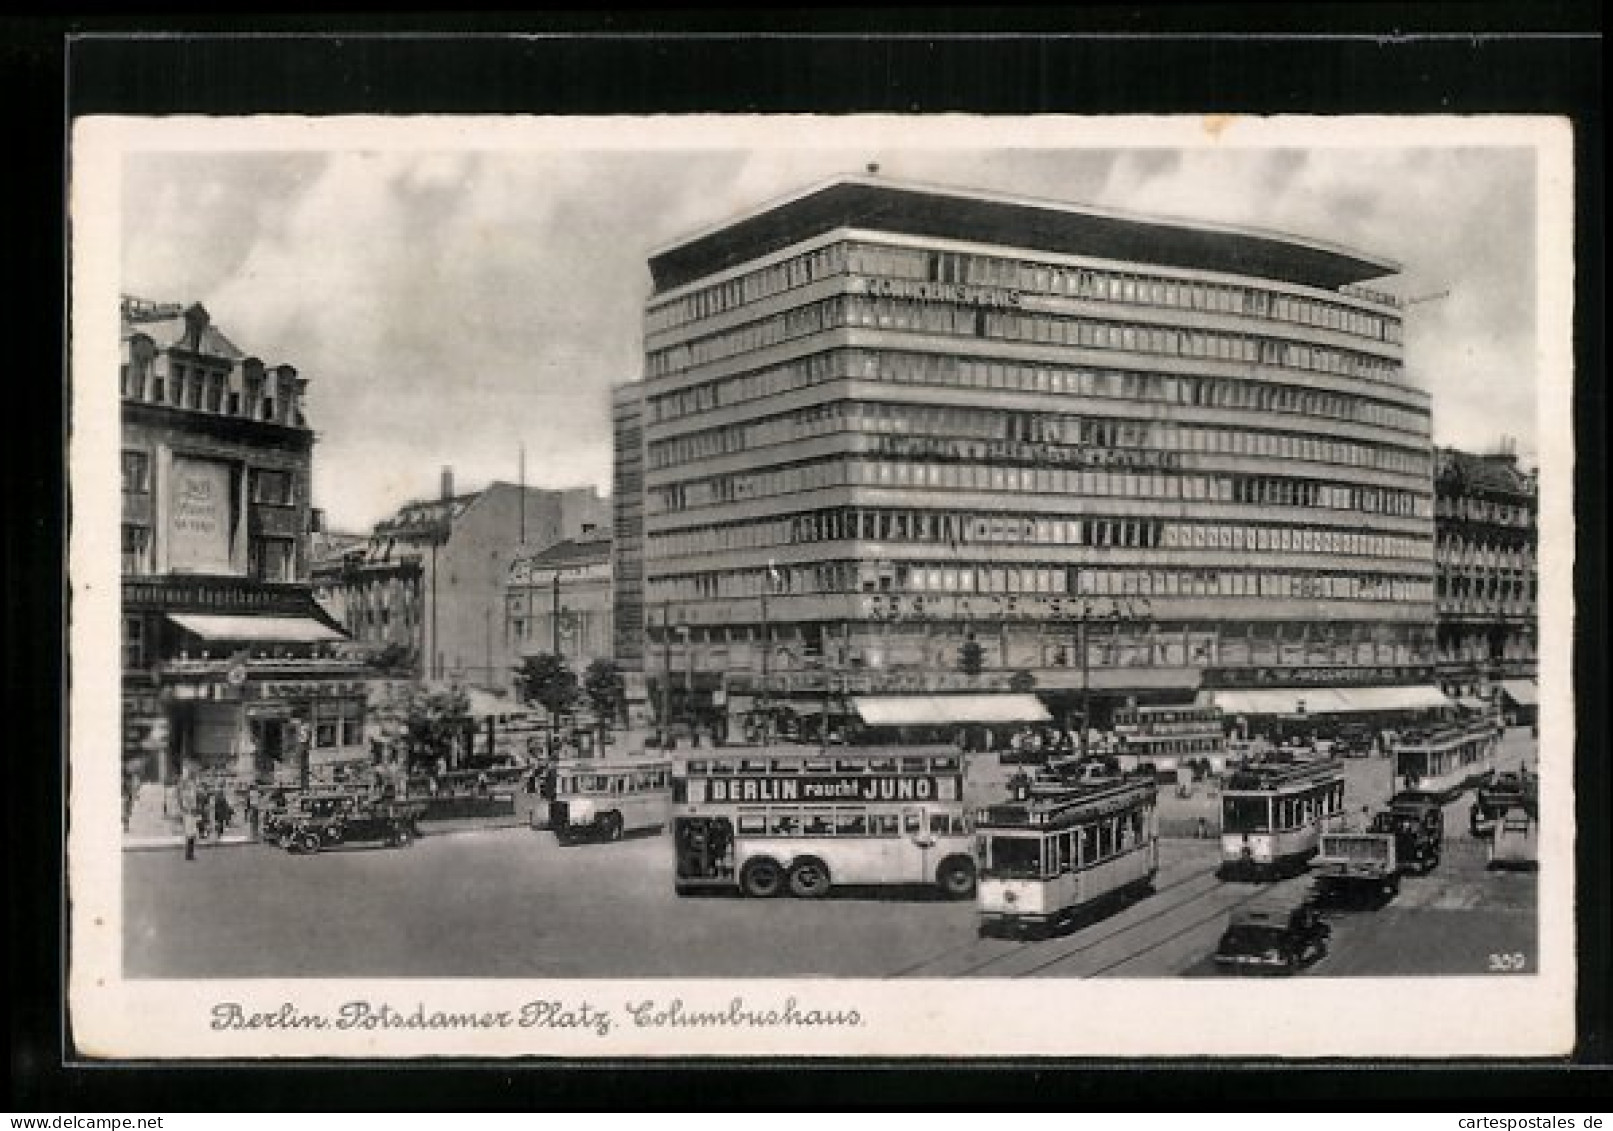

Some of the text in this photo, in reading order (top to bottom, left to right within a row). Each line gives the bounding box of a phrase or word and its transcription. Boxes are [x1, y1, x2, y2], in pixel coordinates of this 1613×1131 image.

[712, 779, 932, 800] BERLIN raucht JUNO
